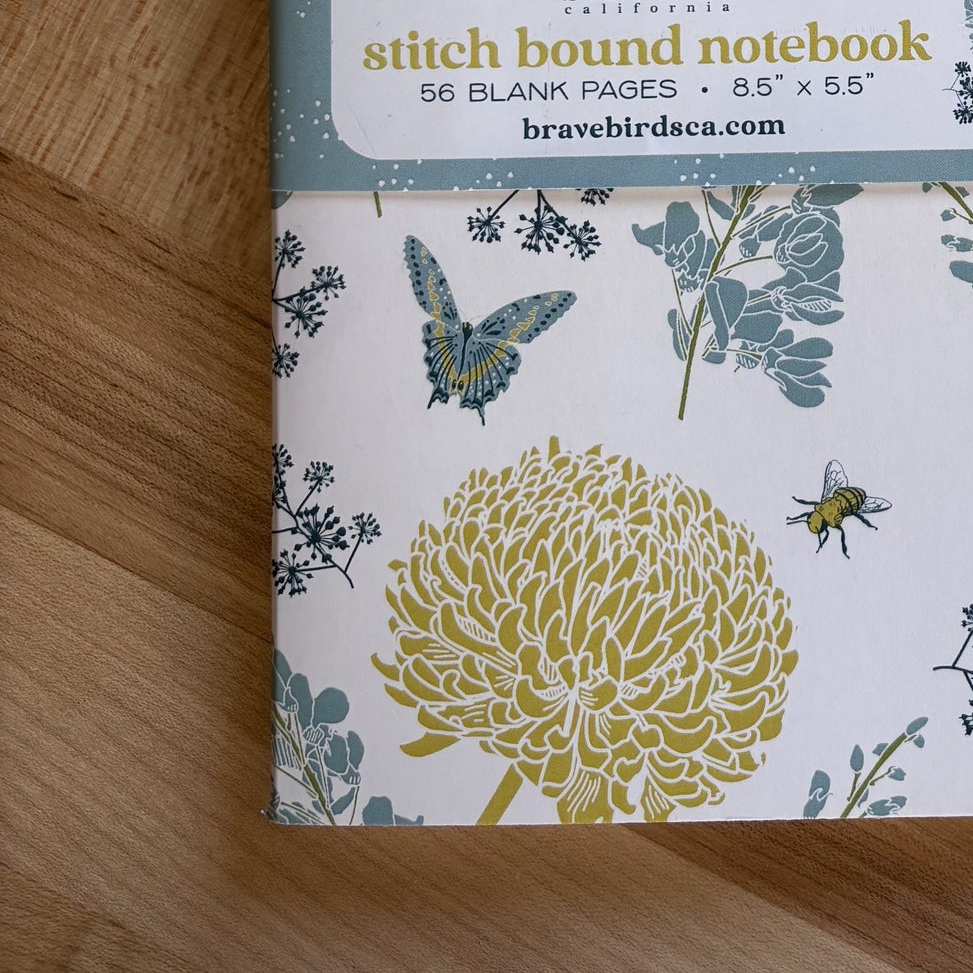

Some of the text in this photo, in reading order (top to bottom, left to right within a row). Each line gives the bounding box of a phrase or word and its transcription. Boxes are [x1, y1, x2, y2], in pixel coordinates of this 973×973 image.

[564, 1, 731, 15] california
[362, 19, 933, 70] stitch bound notebook
[420, 82, 455, 103] 56
[468, 80, 570, 102] BLANK
[581, 78, 679, 101] PAGES
[522, 113, 786, 141] bravebirdsca.com
